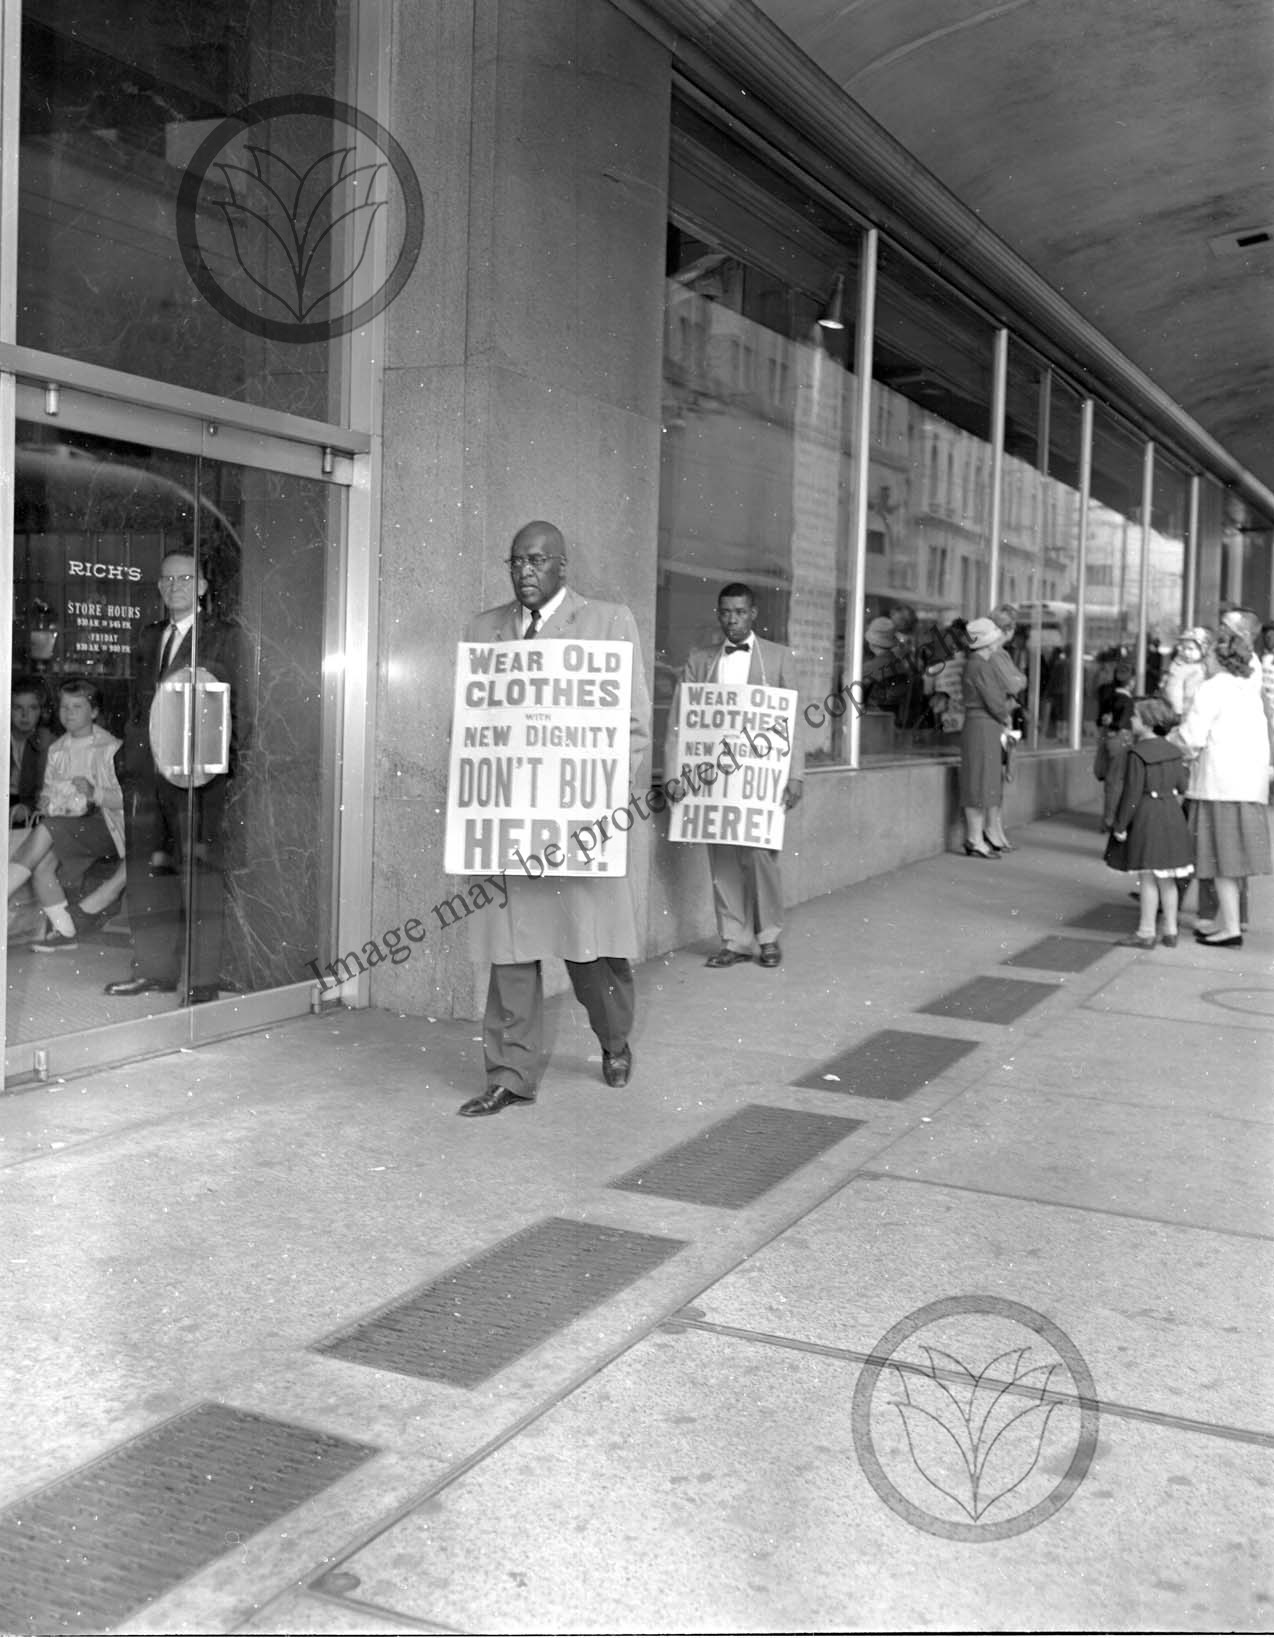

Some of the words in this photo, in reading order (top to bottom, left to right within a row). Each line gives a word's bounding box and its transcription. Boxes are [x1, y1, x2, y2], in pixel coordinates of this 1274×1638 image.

[68, 560, 141, 581] RICH'S
[67, 602, 102, 616] STORE
[107, 605, 141, 619] HOURS
[90, 633, 119, 642] FRIDAY
[469, 648, 544, 675] WEAR
[563, 644, 621, 673] OLD
[465, 678, 621, 708] CLOTHES
[688, 686, 738, 706] WEAR
[751, 688, 790, 711] OLD
[525, 713, 551, 721] WITH
[686, 710, 787, 733] CLOTHES
[464, 725, 512, 748] NEW
[525, 725, 618, 748] DIGNITY
[685, 742, 715, 756] NEW
[458, 757, 544, 809] DON'T
[559, 758, 619, 810] BUY
[742, 765, 783, 803] BUY
[680, 804, 774, 845] HERE!
[464, 818, 609, 872] HERE!
